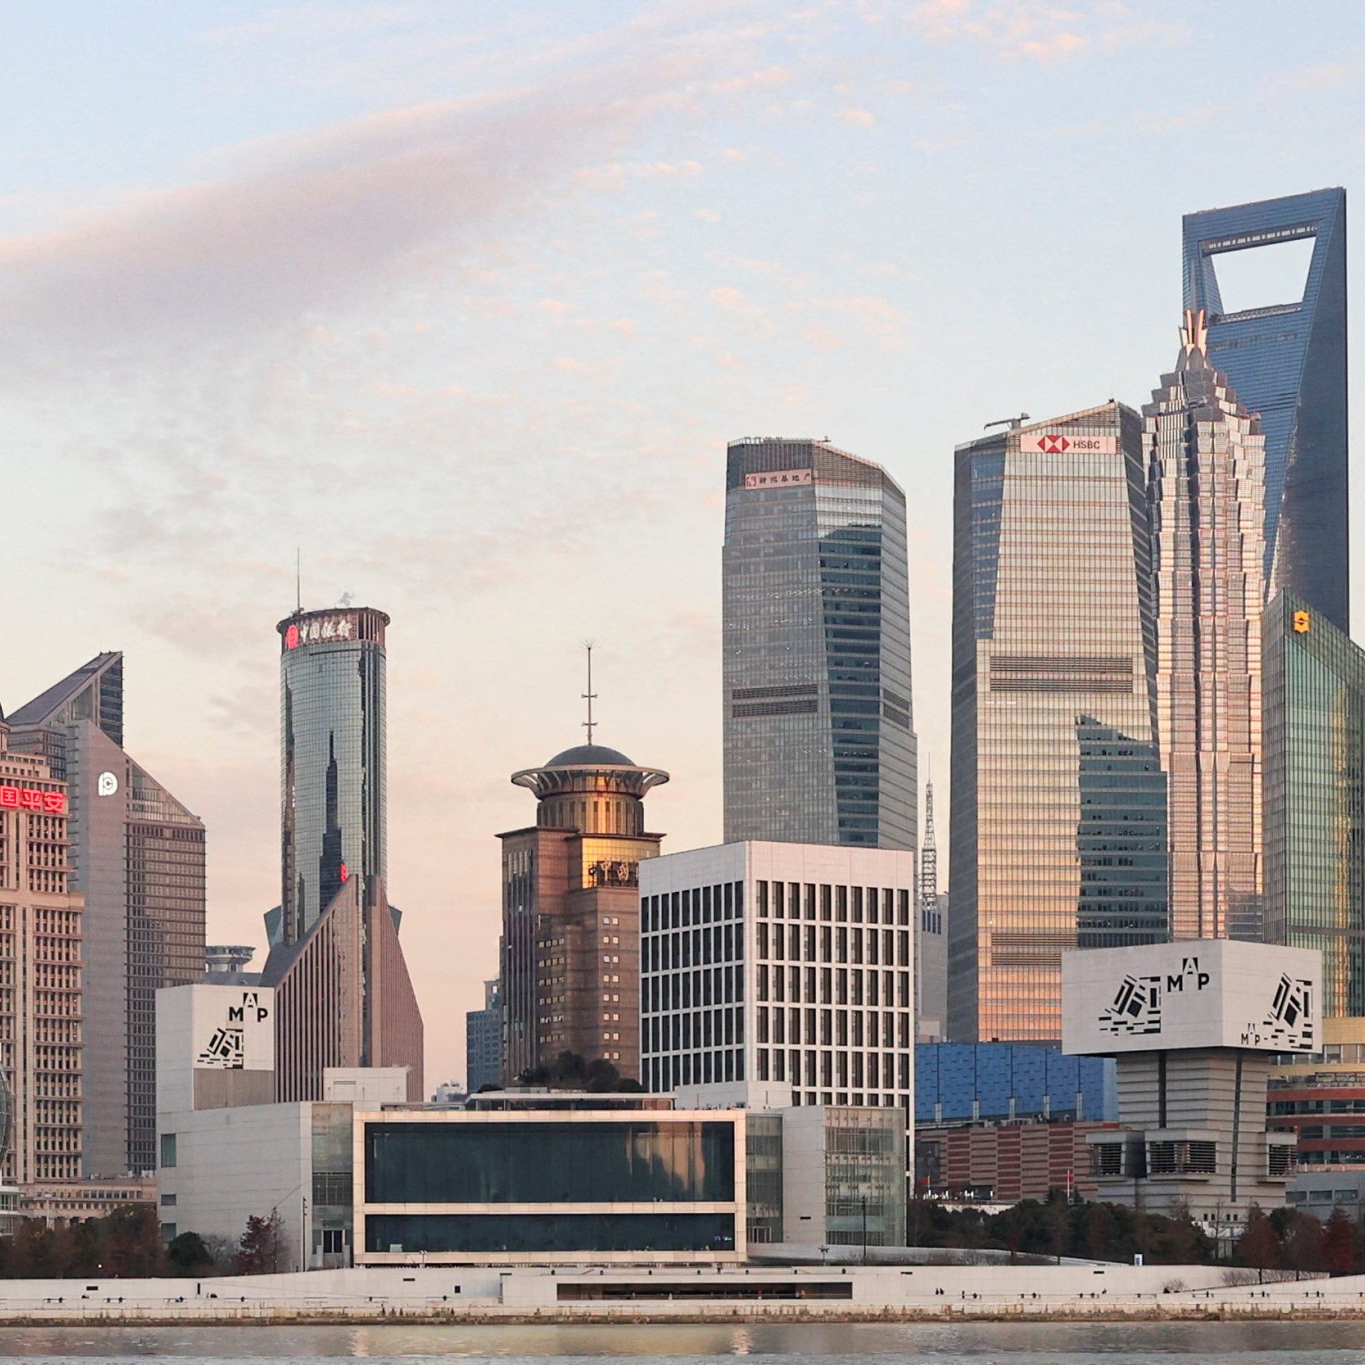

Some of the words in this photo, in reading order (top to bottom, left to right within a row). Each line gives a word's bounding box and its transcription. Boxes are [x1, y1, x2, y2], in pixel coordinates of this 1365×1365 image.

[1073, 441, 1100, 450] HSBC
[1167, 957, 1210, 992] MAP
[229, 992, 268, 1022] MAP
[1241, 1022, 1261, 1046] MAP
